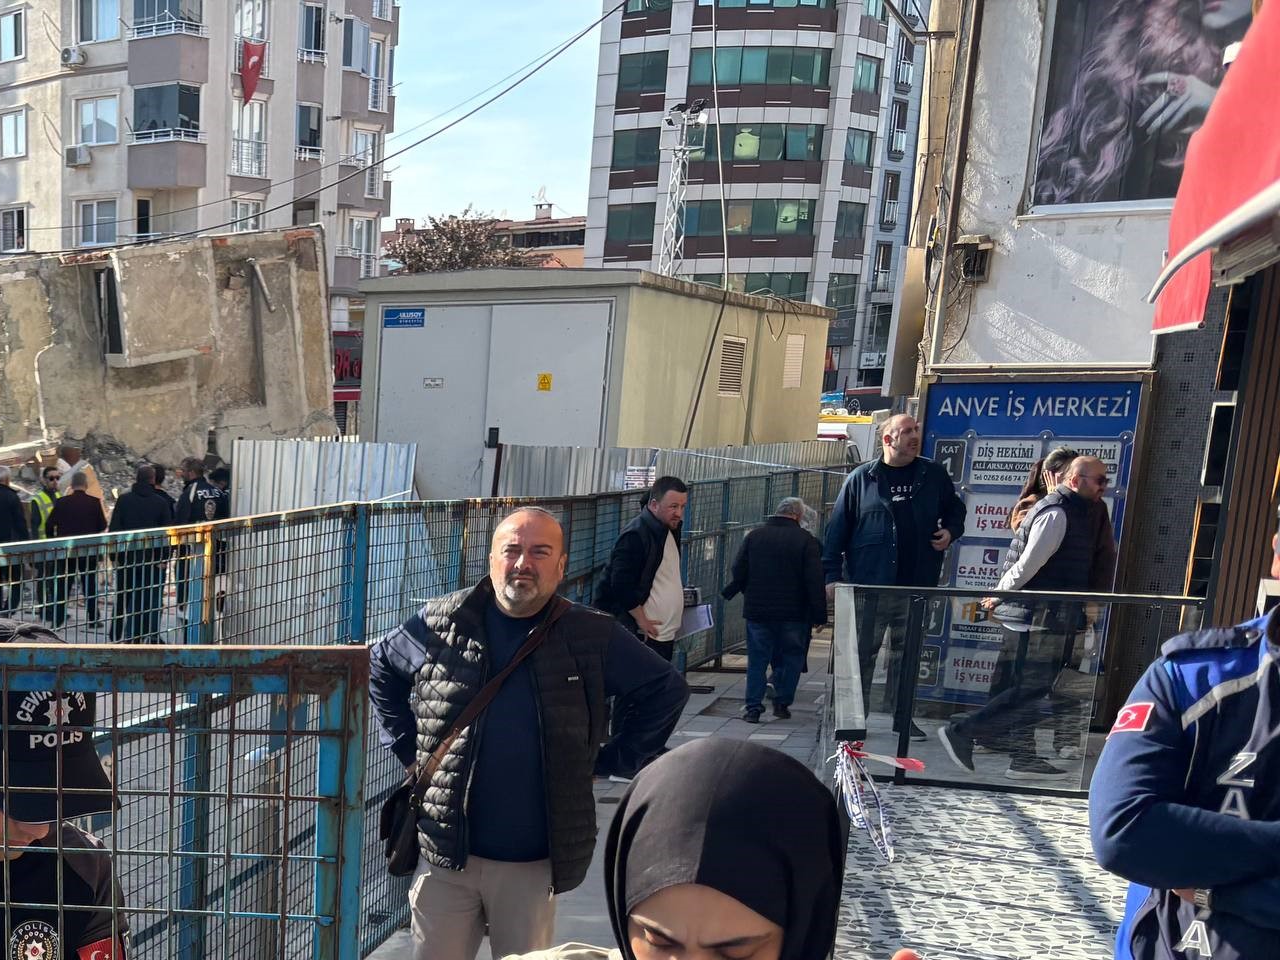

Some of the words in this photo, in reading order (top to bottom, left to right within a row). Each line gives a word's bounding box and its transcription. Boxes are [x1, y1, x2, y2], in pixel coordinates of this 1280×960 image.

[938, 396, 1000, 418] ANVE
[1007, 390, 1025, 421] İŞ
[1032, 390, 1132, 418] MERKEZİ
[940, 445, 960, 454] KAT
[977, 442, 994, 460] DİŞ
[996, 442, 1034, 459] HEKİMİ
[987, 462, 1014, 470] ARSLAN
[975, 502, 1009, 516] KİRAL
[976, 516, 987, 529] İŞ
[958, 566, 999, 577] CANK
[955, 669, 966, 683] İŞ
